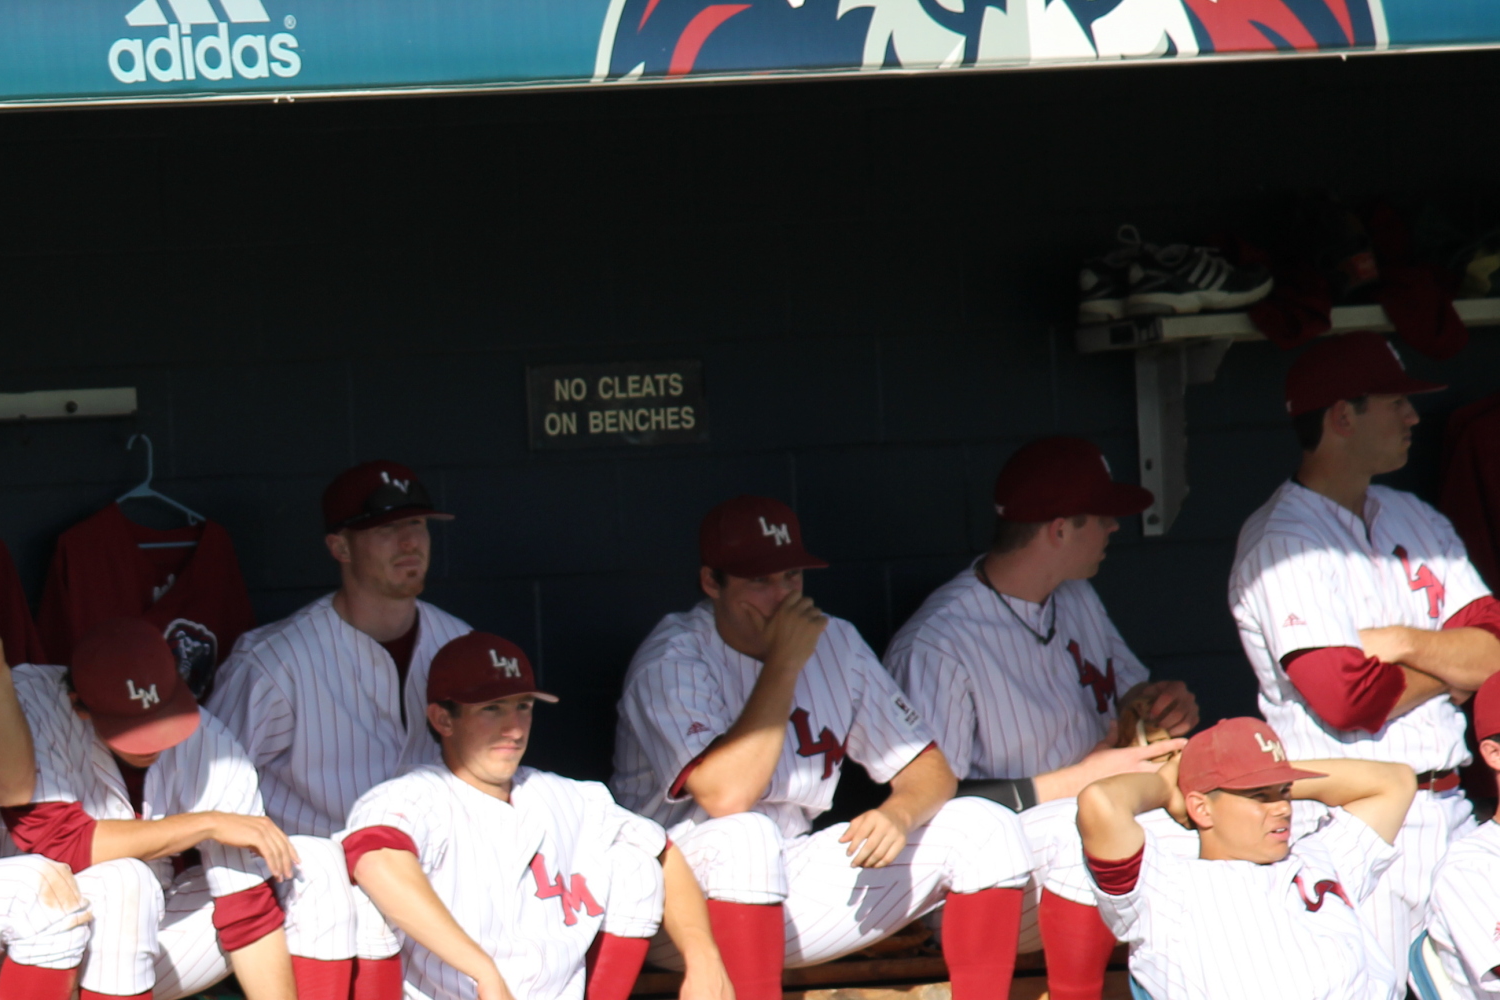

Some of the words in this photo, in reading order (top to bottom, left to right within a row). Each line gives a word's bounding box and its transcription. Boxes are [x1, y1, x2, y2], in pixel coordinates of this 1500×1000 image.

[108, 22, 302, 84] adidas
[554, 378, 587, 401] NO
[598, 373, 684, 399] CLEATS
[544, 412, 577, 436] ON
[588, 406, 696, 434] BENCHES
[758, 516, 792, 546] LM
[488, 648, 522, 678] LM
[126, 678, 161, 709] LM
[527, 850, 606, 928] LM
